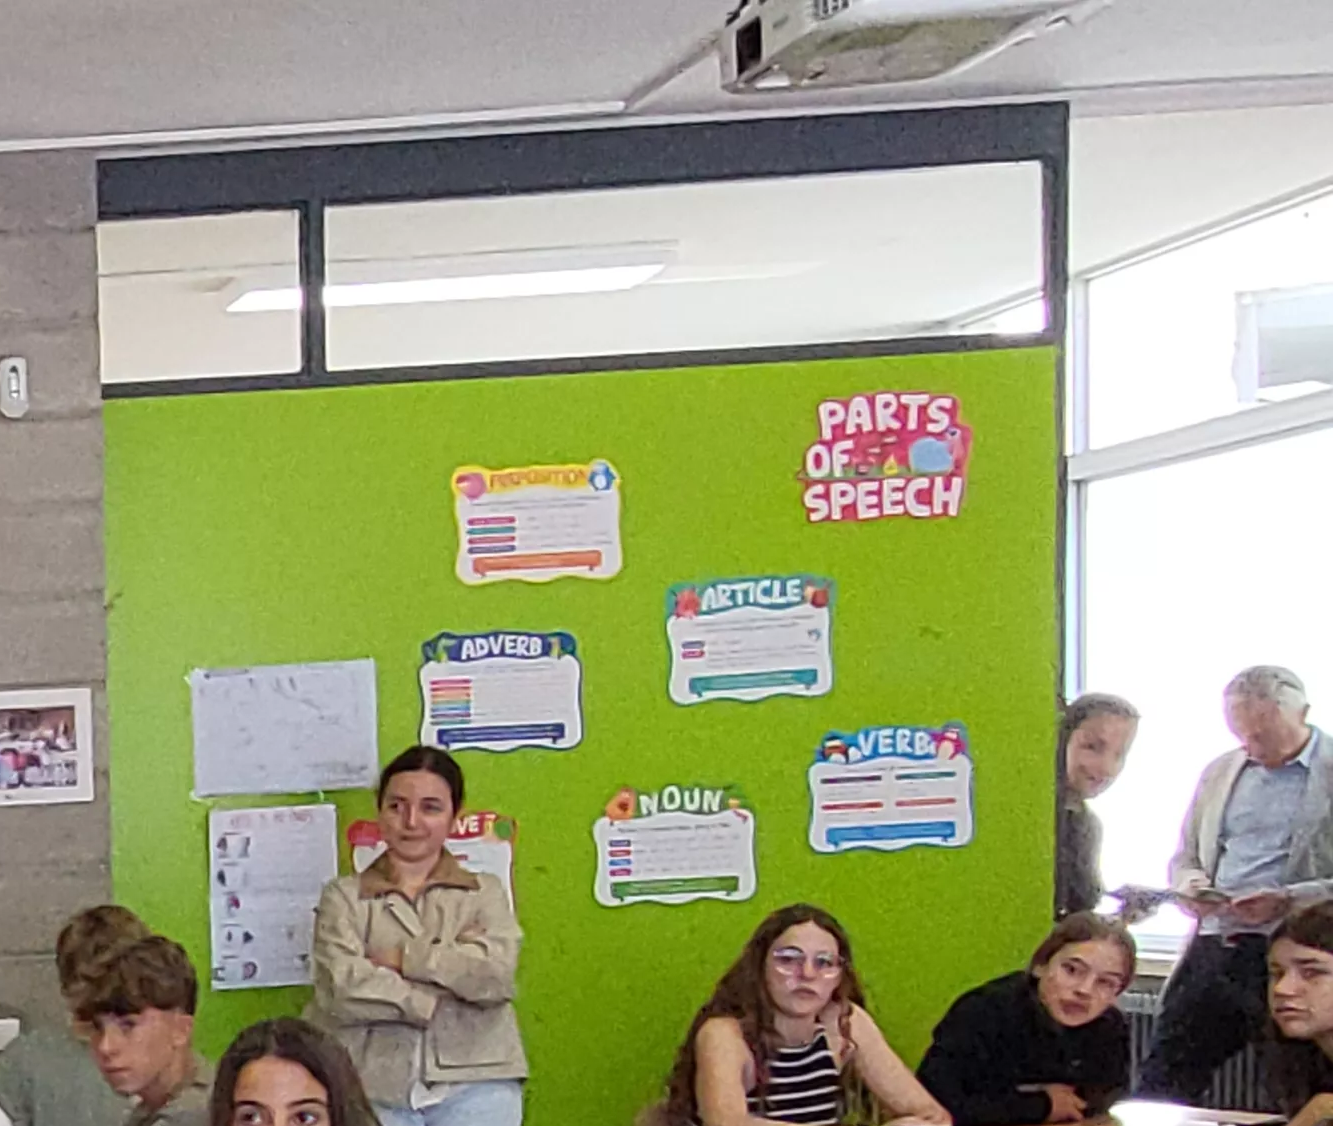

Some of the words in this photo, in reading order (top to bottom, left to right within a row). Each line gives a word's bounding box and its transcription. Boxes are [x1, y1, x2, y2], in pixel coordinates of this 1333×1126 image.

[818, 393, 953, 440] PARTS
[805, 440, 855, 478] OF
[804, 476, 963, 521] SPEECH
[702, 578, 803, 611] ARTICLE
[461, 635, 543, 660] ADVERB
[858, 728, 934, 756] VERB
[639, 785, 724, 815] NOUN
